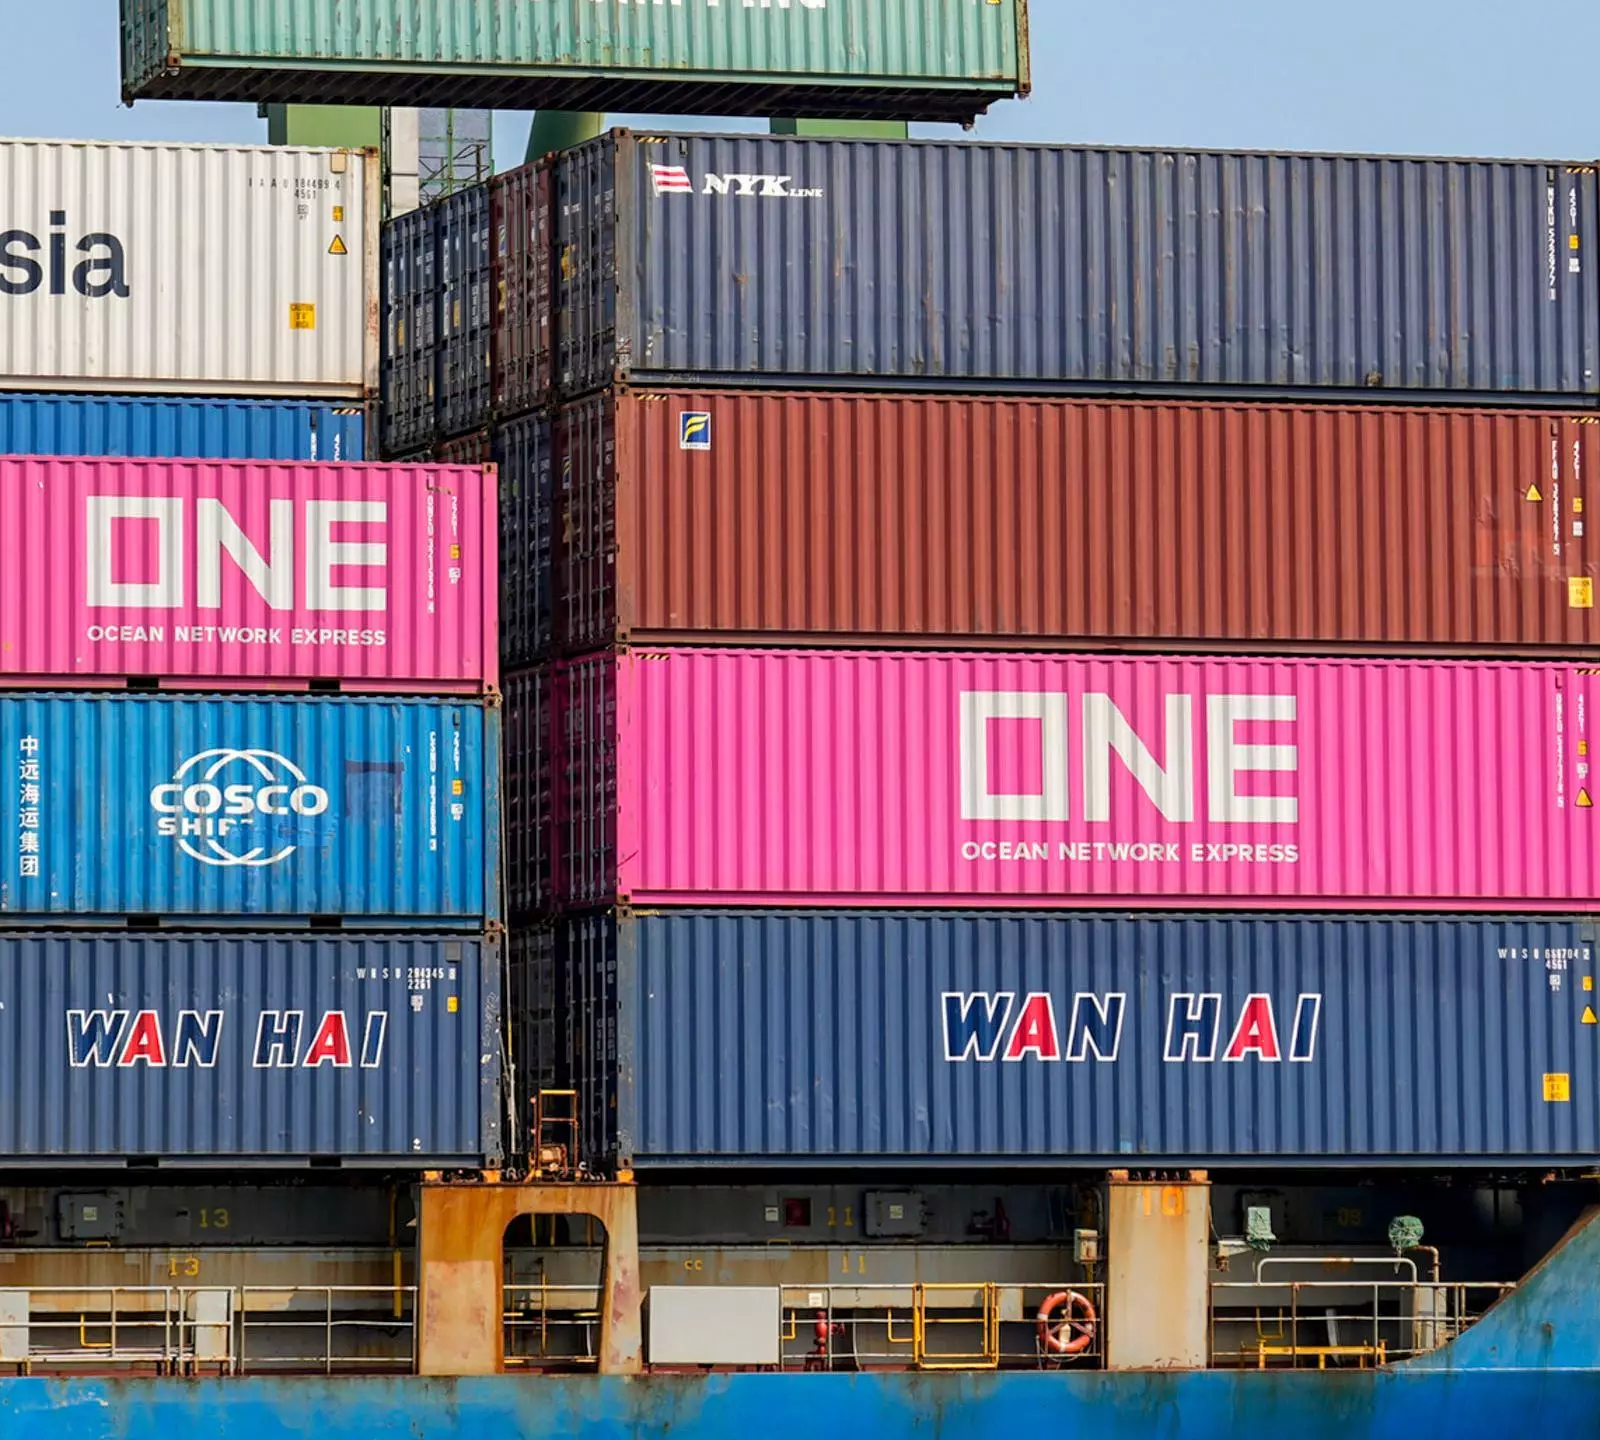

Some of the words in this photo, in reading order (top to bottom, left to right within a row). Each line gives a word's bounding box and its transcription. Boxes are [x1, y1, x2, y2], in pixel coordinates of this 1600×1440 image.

[702, 173, 792, 197] NYK
[86, 496, 387, 611] ONE
[87, 625, 165, 644] OCEAN
[174, 626, 282, 645] NETWORK
[291, 628, 387, 647] EXPRESS
[959, 691, 1299, 823] ONE
[18, 735, 40, 877] 中远海运集团
[150, 783, 329, 817] COSCO
[960, 840, 1049, 861] OCEAN
[1059, 841, 1181, 863] NETWORK
[1190, 843, 1299, 864] EXPRESS
[67, 1010, 224, 1068] WAN
[252, 1011, 388, 1068] HAI
[941, 992, 1127, 1062] WAN
[1164, 992, 1322, 1063] HAI
[1142, 1186, 1185, 1217] 10
[199, 1208, 229, 1228] 13
[168, 1256, 200, 1277] 13
[840, 1253, 868, 1274] 11
